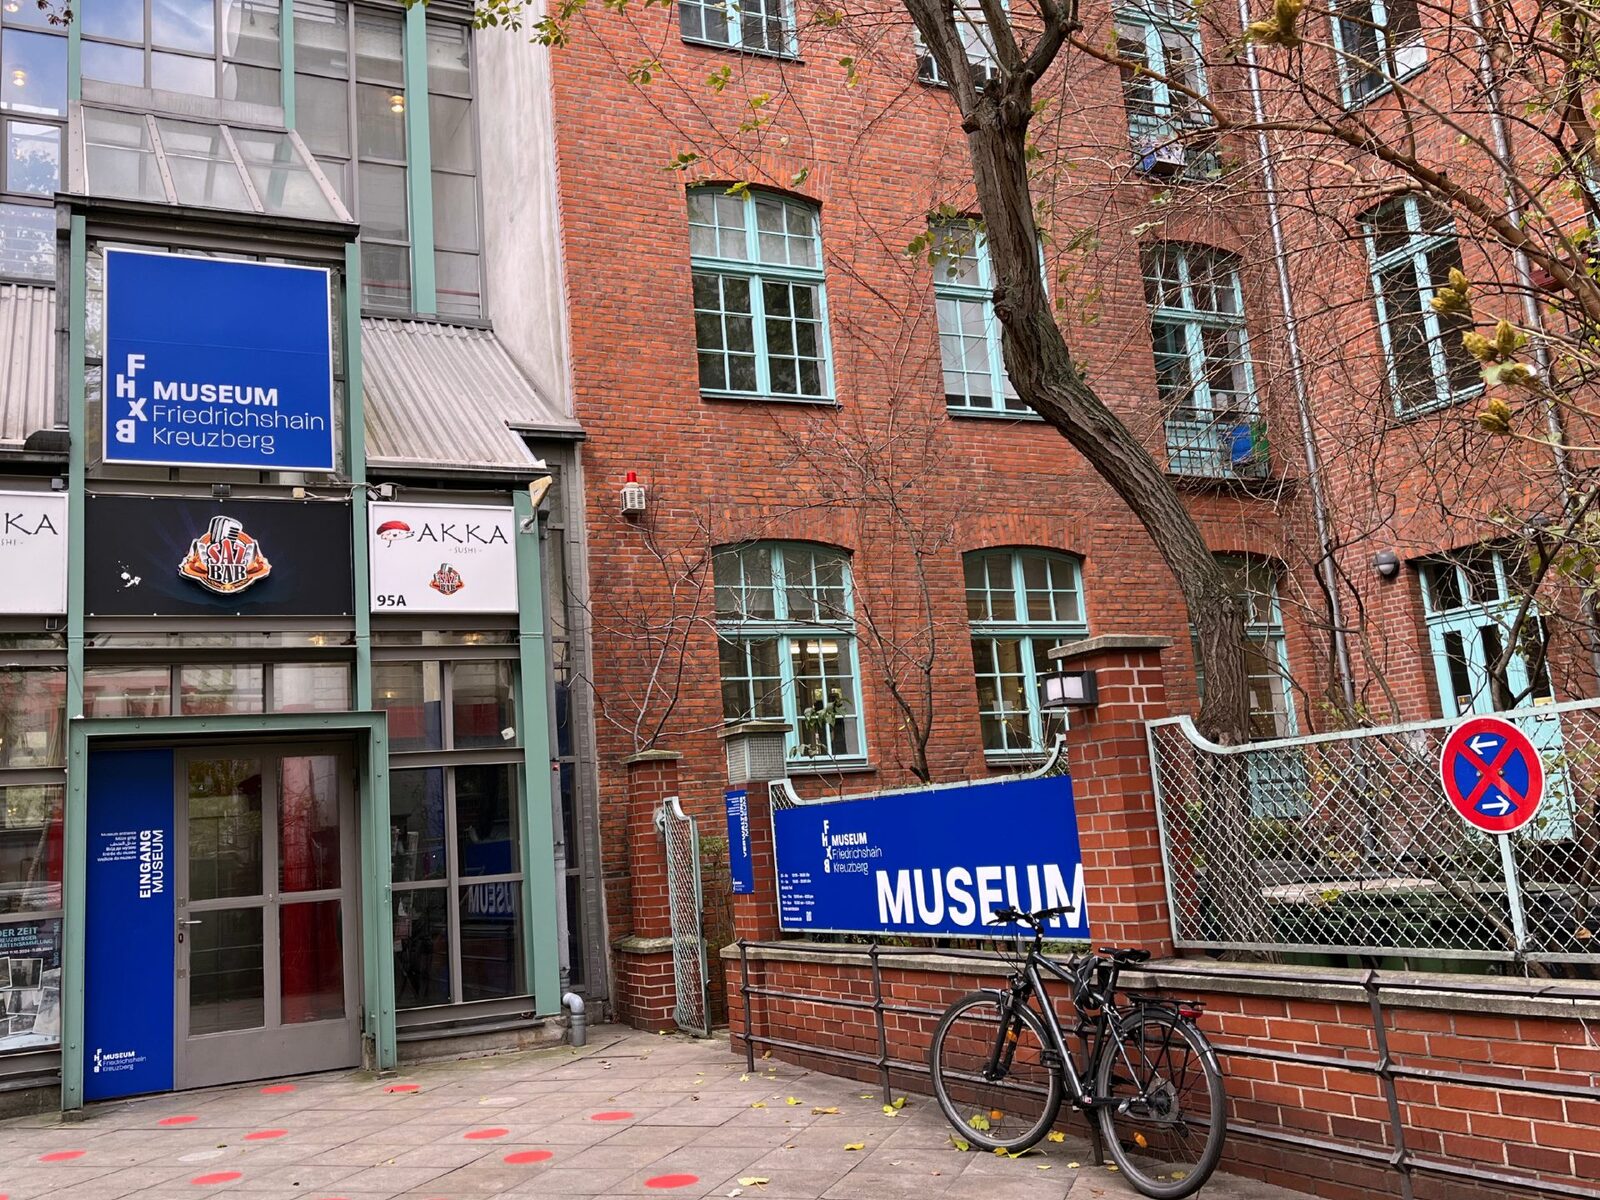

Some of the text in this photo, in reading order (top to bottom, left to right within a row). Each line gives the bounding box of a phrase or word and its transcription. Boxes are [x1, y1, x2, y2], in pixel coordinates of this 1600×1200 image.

[153, 381, 278, 406] MUSEUM
[153, 405, 324, 431] Friedrichshain
[153, 427, 275, 455] Kreuzberg
[417, 523, 508, 544] AKKA
[208, 538, 246, 565] SAZ
[208, 564, 247, 584] BAR
[377, 594, 407, 607] 95A
[831, 832, 868, 847] MUSEUM
[152, 830, 164, 893] MUSEUM
[832, 846, 883, 860] Friedrichshain
[140, 830, 152, 898] EINGANG
[833, 861, 869, 876] Kreuzberg
[876, 863, 1090, 929] MUSEUM
[17, 927, 38, 935] ZEIT
[103, 1051, 135, 1060] MUSEUM
